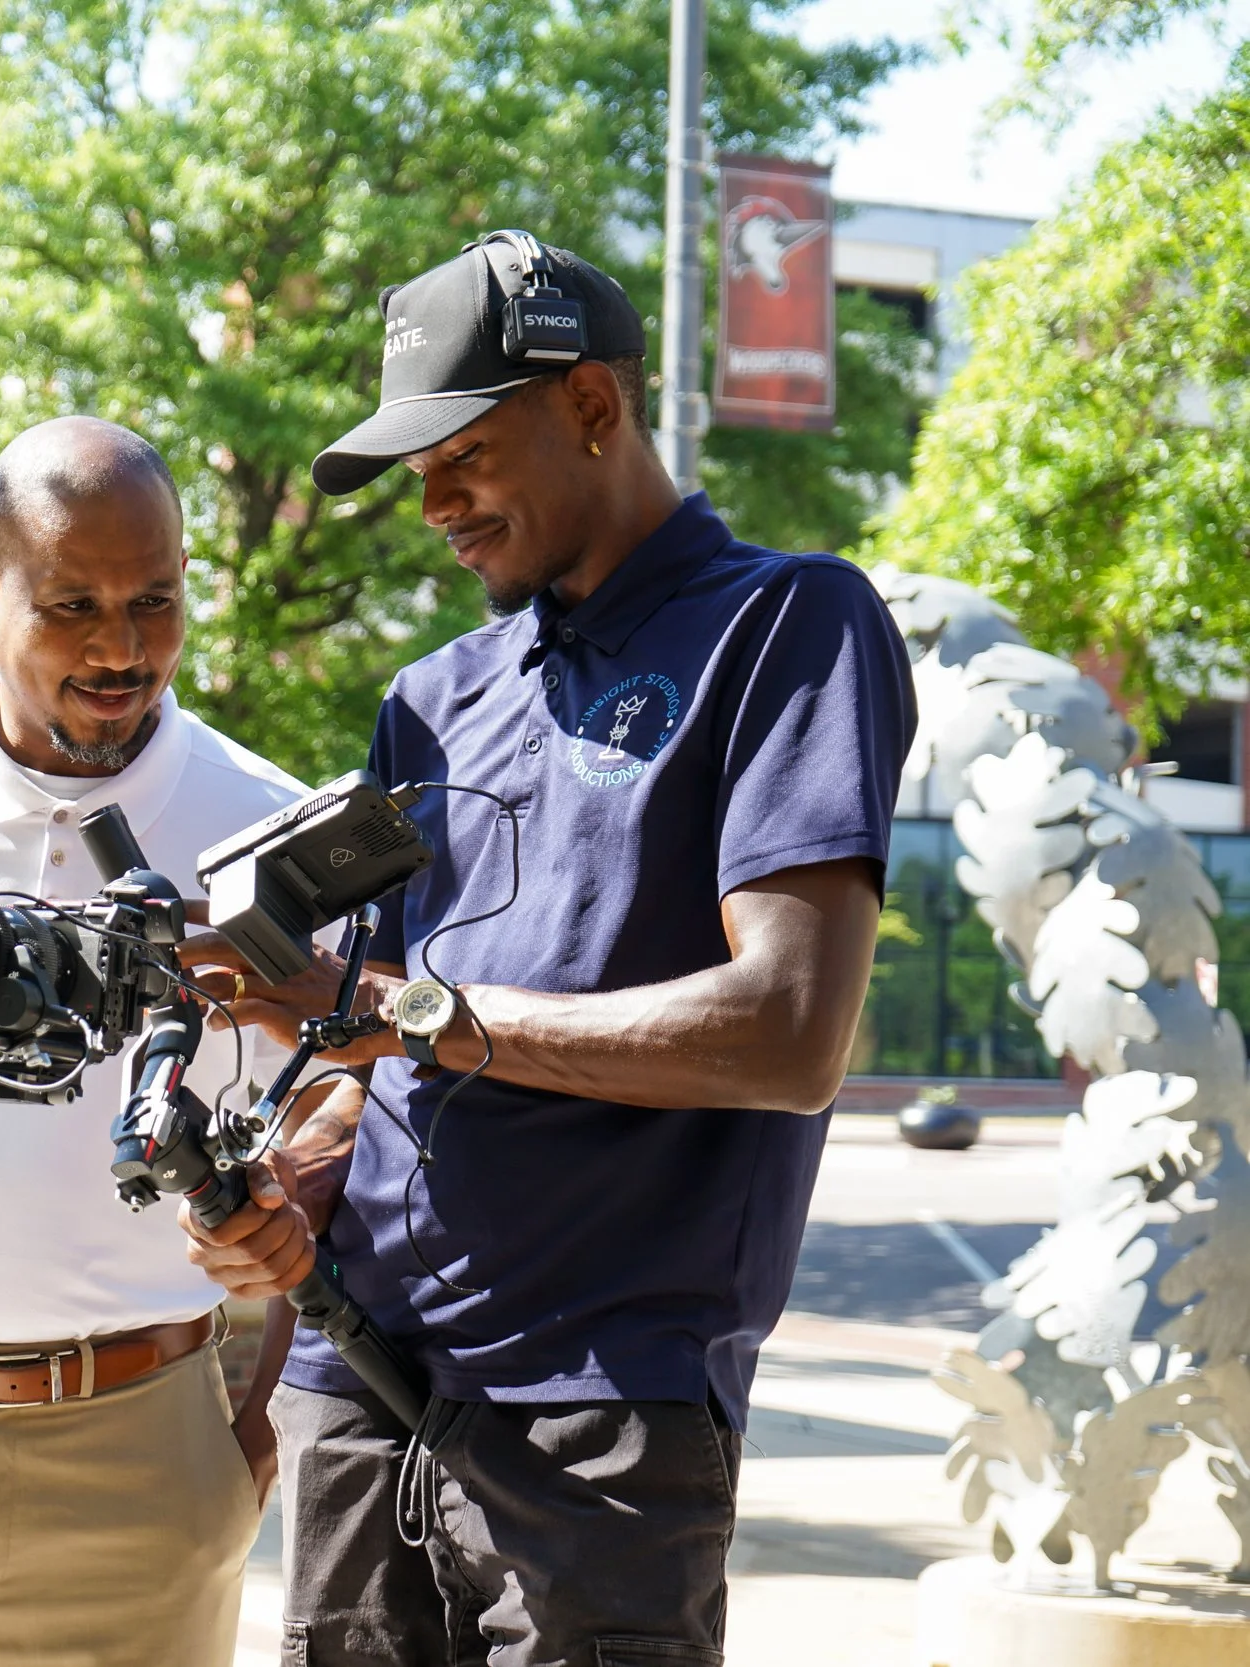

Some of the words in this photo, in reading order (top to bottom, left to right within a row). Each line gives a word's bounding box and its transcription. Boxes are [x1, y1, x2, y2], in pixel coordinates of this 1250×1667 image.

[524, 314, 574, 328] SYNCO
[581, 675, 642, 722] INSIGHT
[645, 673, 680, 718] STUDIOS
[648, 731, 670, 759] LLC
